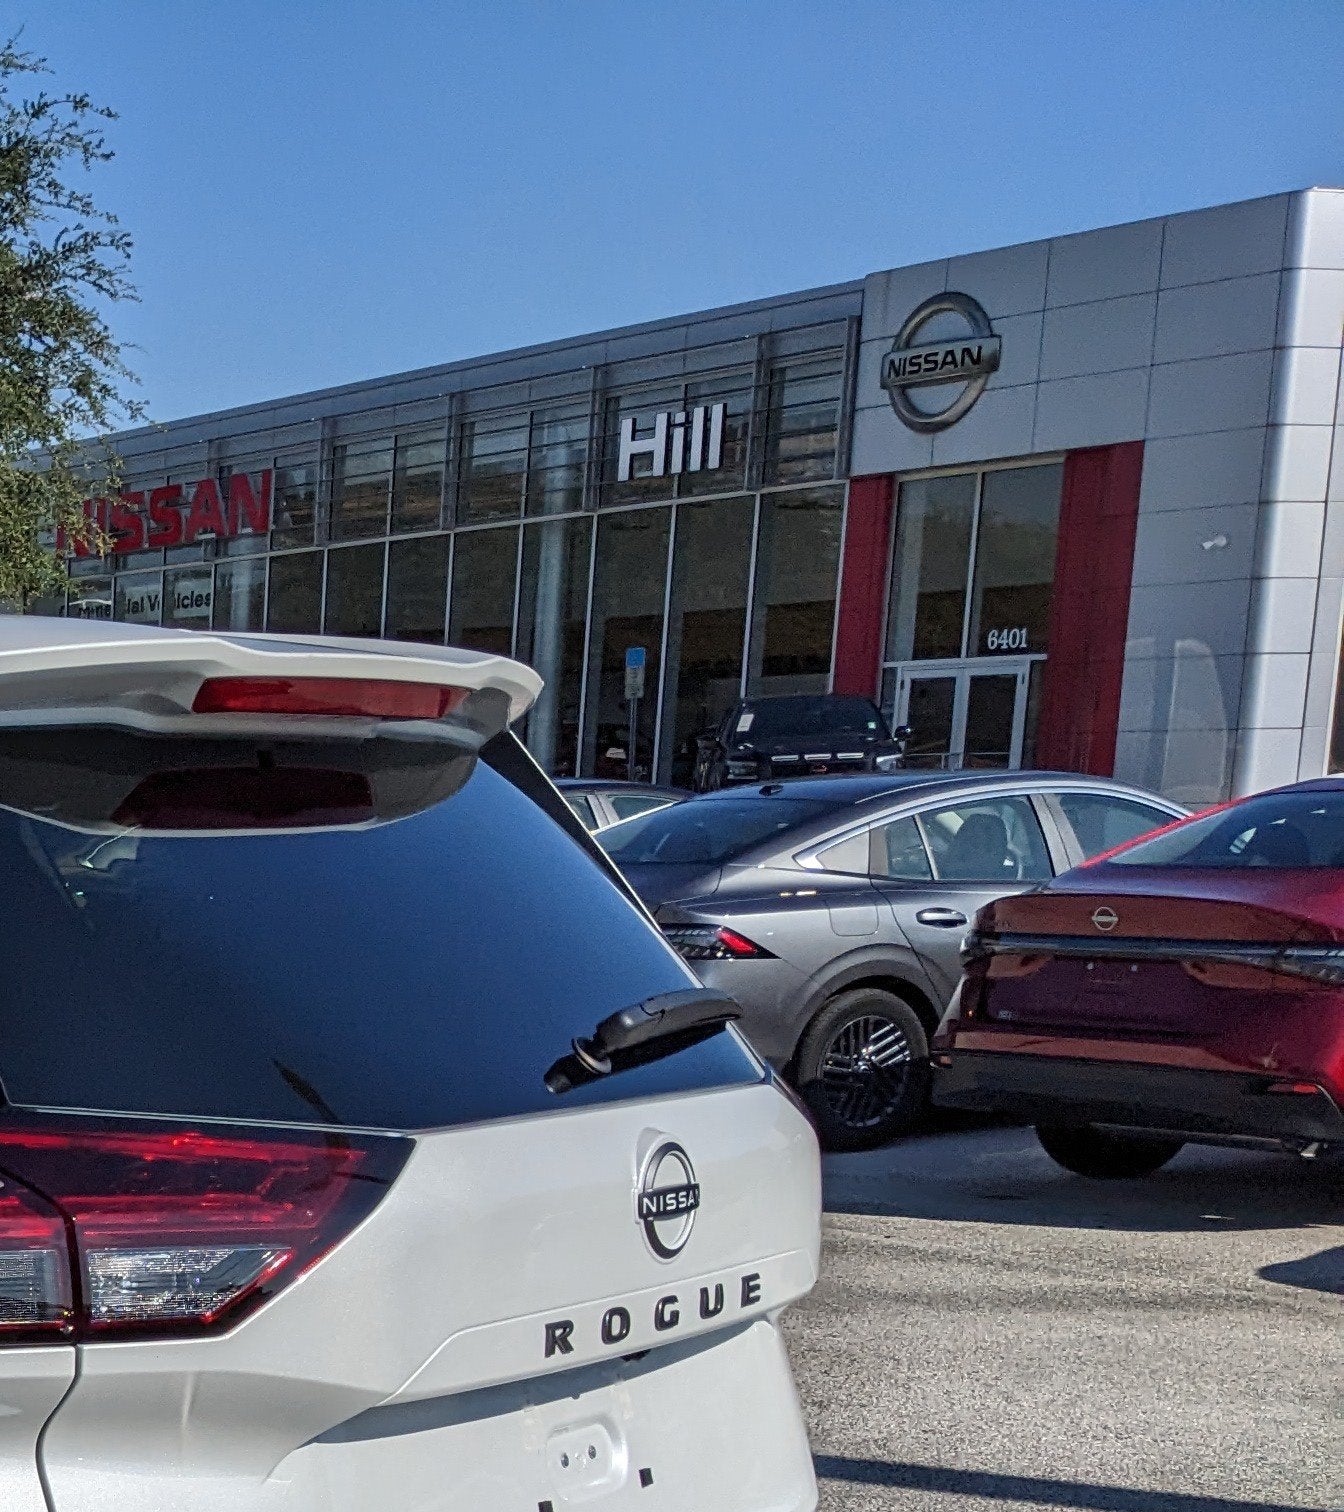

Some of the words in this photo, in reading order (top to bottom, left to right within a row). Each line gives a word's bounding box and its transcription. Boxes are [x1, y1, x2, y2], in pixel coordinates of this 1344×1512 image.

[888, 345, 983, 378] NISSAN
[618, 403, 727, 481] Hill
[988, 628, 1027, 650] 6401
[642, 1188, 700, 1214] NISSA
[544, 1272, 762, 1358] ROGUE
